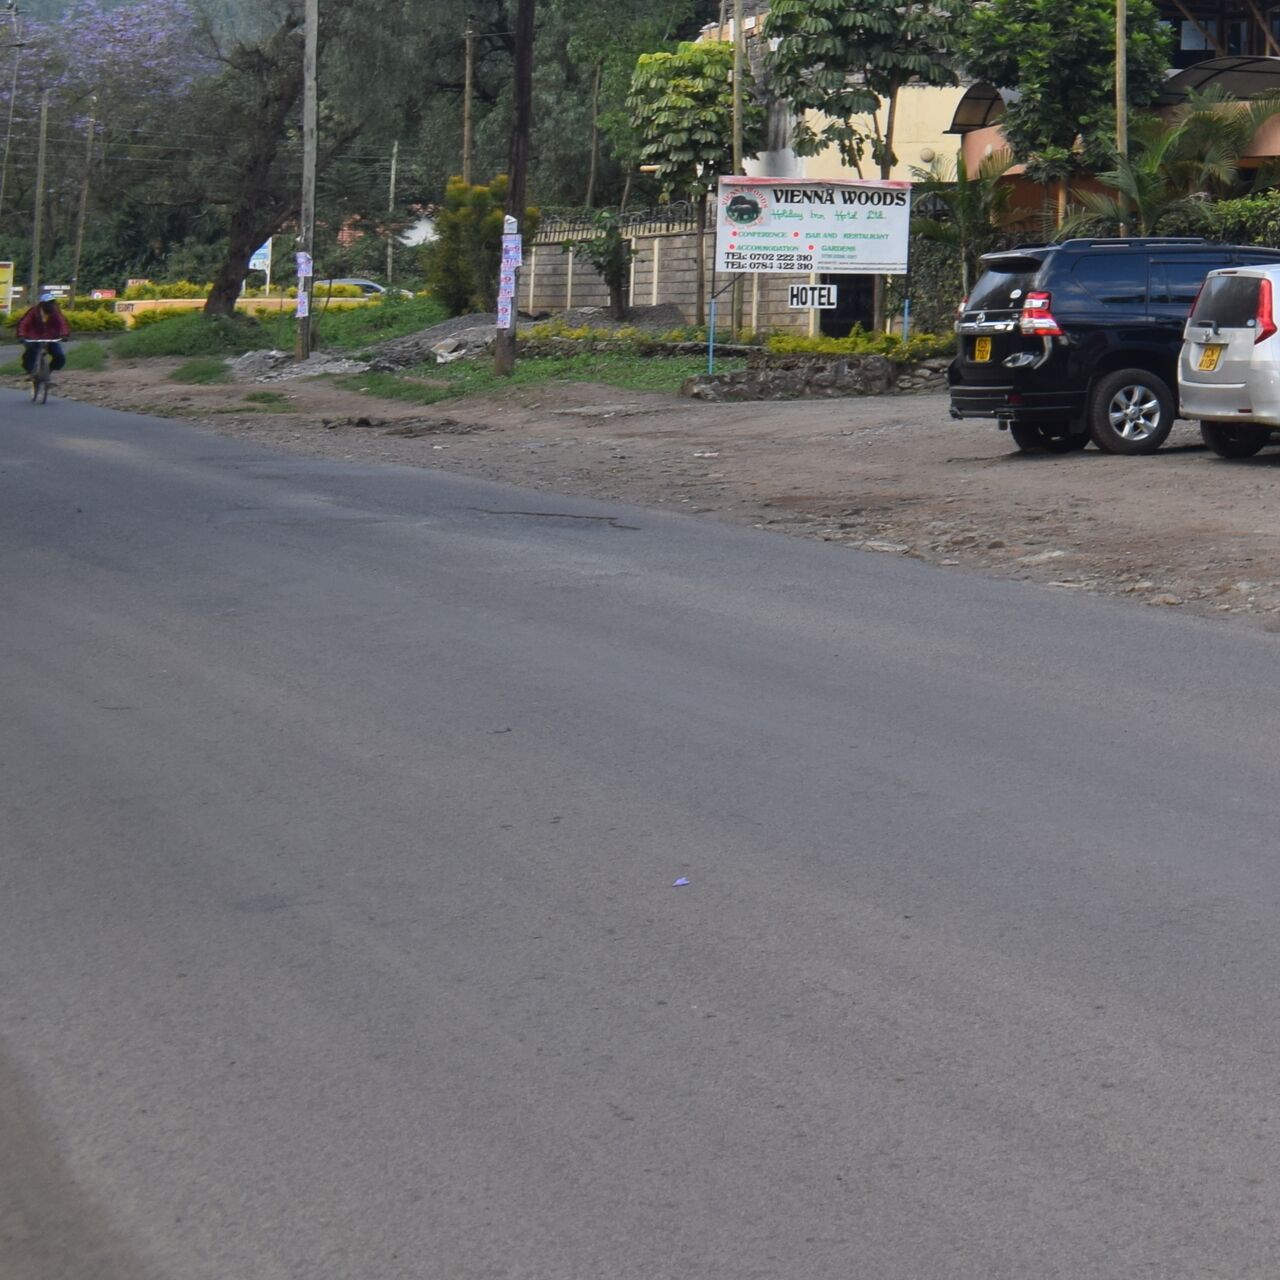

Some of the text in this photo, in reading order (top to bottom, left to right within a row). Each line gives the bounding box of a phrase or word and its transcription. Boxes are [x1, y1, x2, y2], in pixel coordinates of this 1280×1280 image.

[773, 188, 907, 207] VIENNA WOODS
[724, 252, 747, 260] TEL:
[749, 253, 775, 261] 0702
[776, 253, 795, 261] 222
[796, 254, 813, 262] 310
[724, 261, 747, 269] TEL:
[749, 262, 774, 270] 0784
[776, 262, 795, 270] 422
[796, 262, 813, 271] 310
[790, 286, 836, 306] HOTEL
